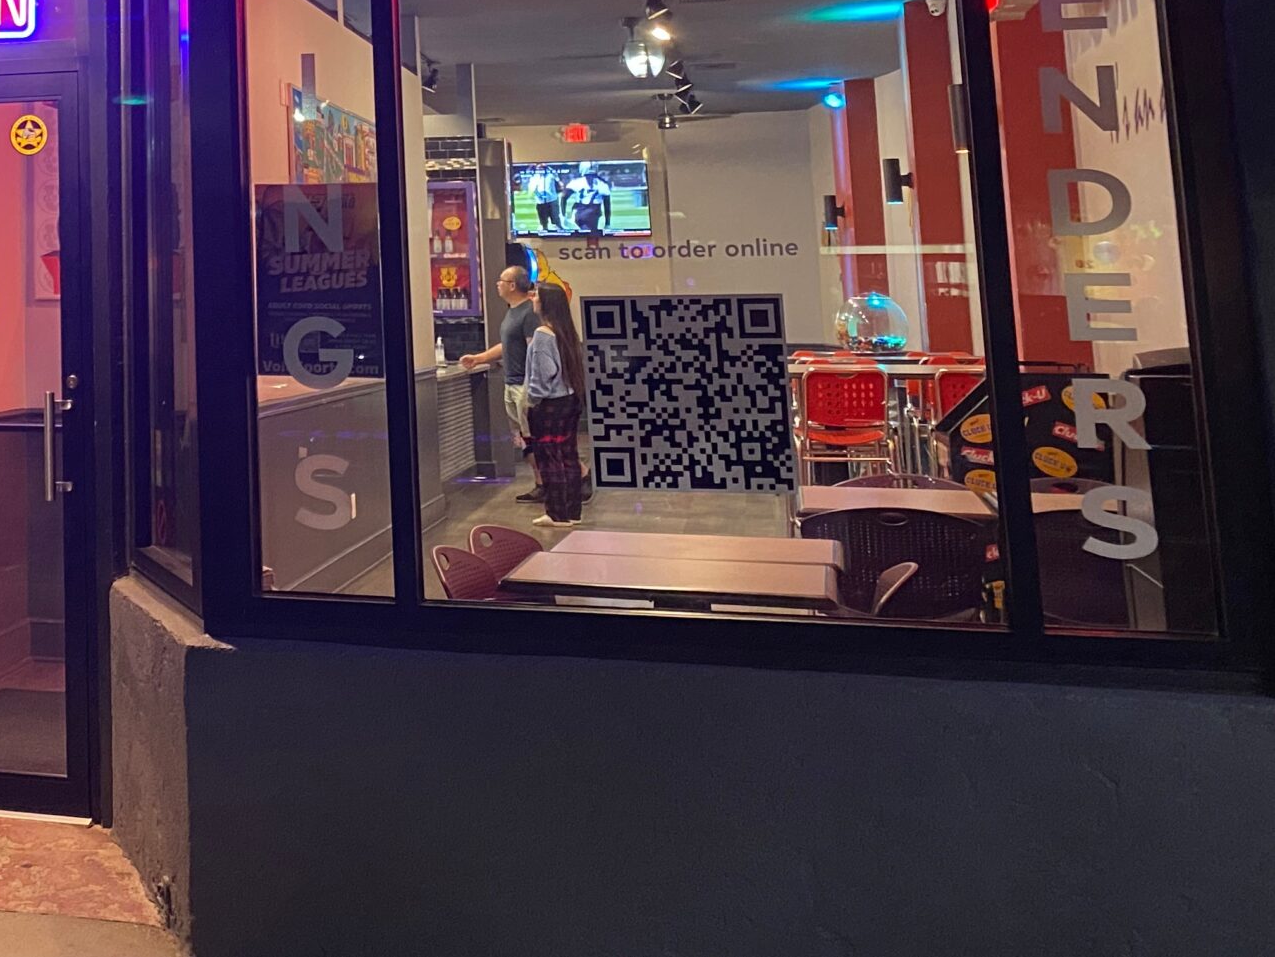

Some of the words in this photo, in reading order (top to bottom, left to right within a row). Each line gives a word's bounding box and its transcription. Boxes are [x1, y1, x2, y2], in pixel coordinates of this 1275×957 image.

[558, 245, 611, 261] scan
[619, 242, 644, 260] to
[652, 239, 717, 259] order
[724, 237, 799, 258] online
[268, 249, 371, 276] SUMMER
[279, 270, 368, 294] LEAGUES
